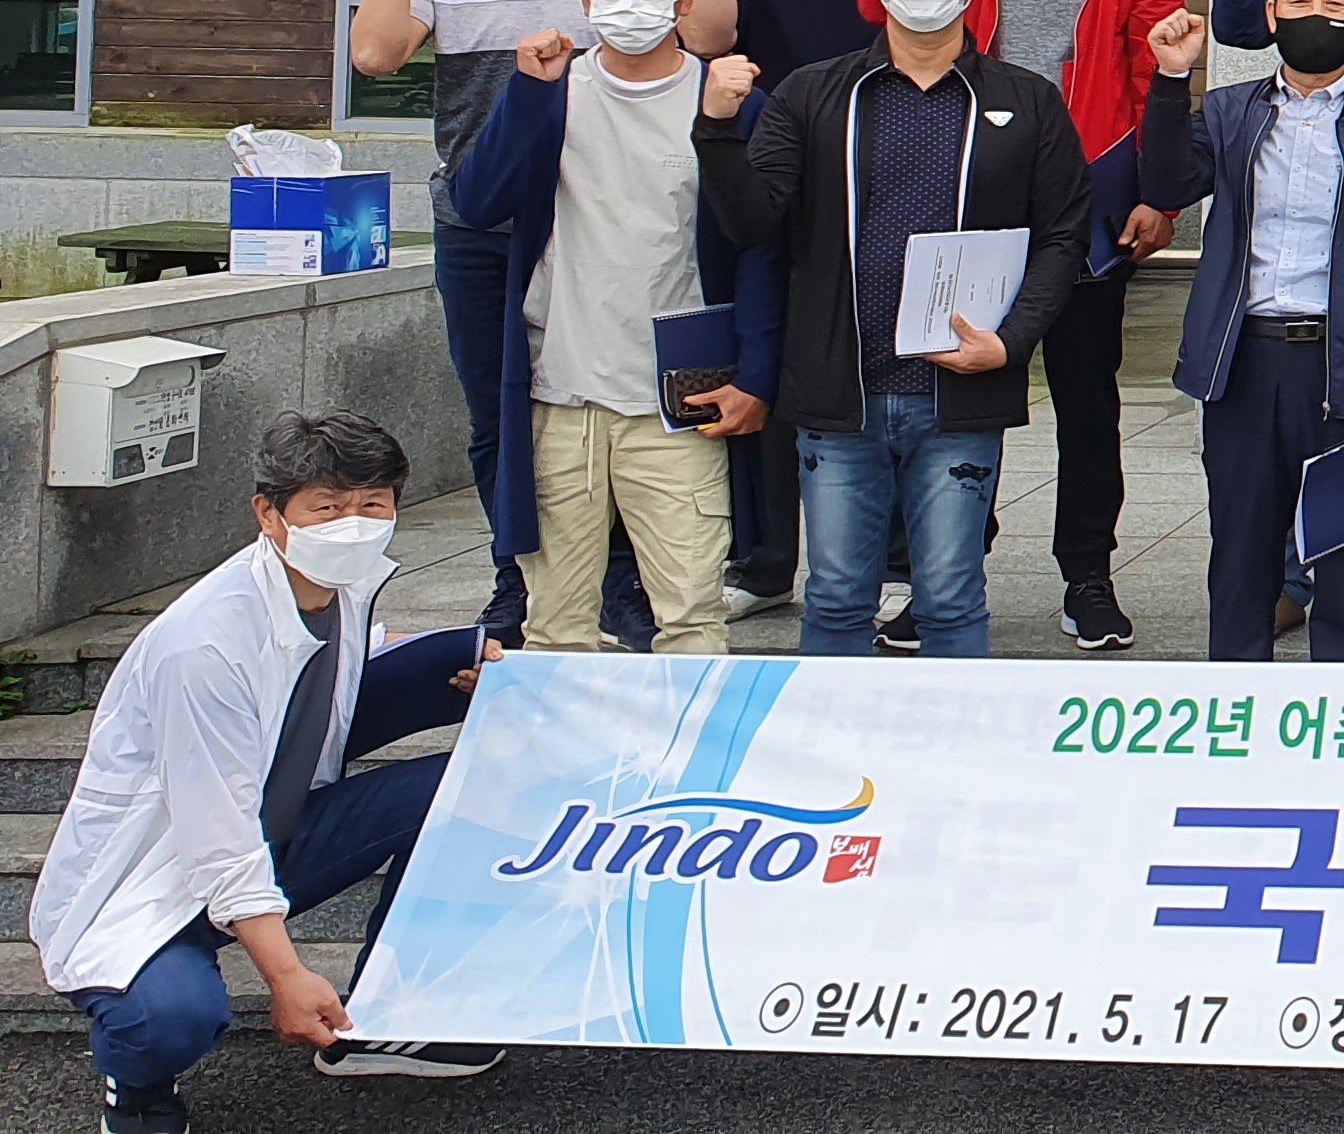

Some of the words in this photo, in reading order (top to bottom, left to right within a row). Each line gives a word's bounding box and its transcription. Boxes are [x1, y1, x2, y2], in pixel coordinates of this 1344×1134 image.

[1052, 695, 1255, 758] 2022년
[497, 804, 818, 882] Jindo
[942, 988, 1079, 1045] 2021.
[1101, 994, 1145, 1047] 5.
[1173, 996, 1229, 1045] 17
